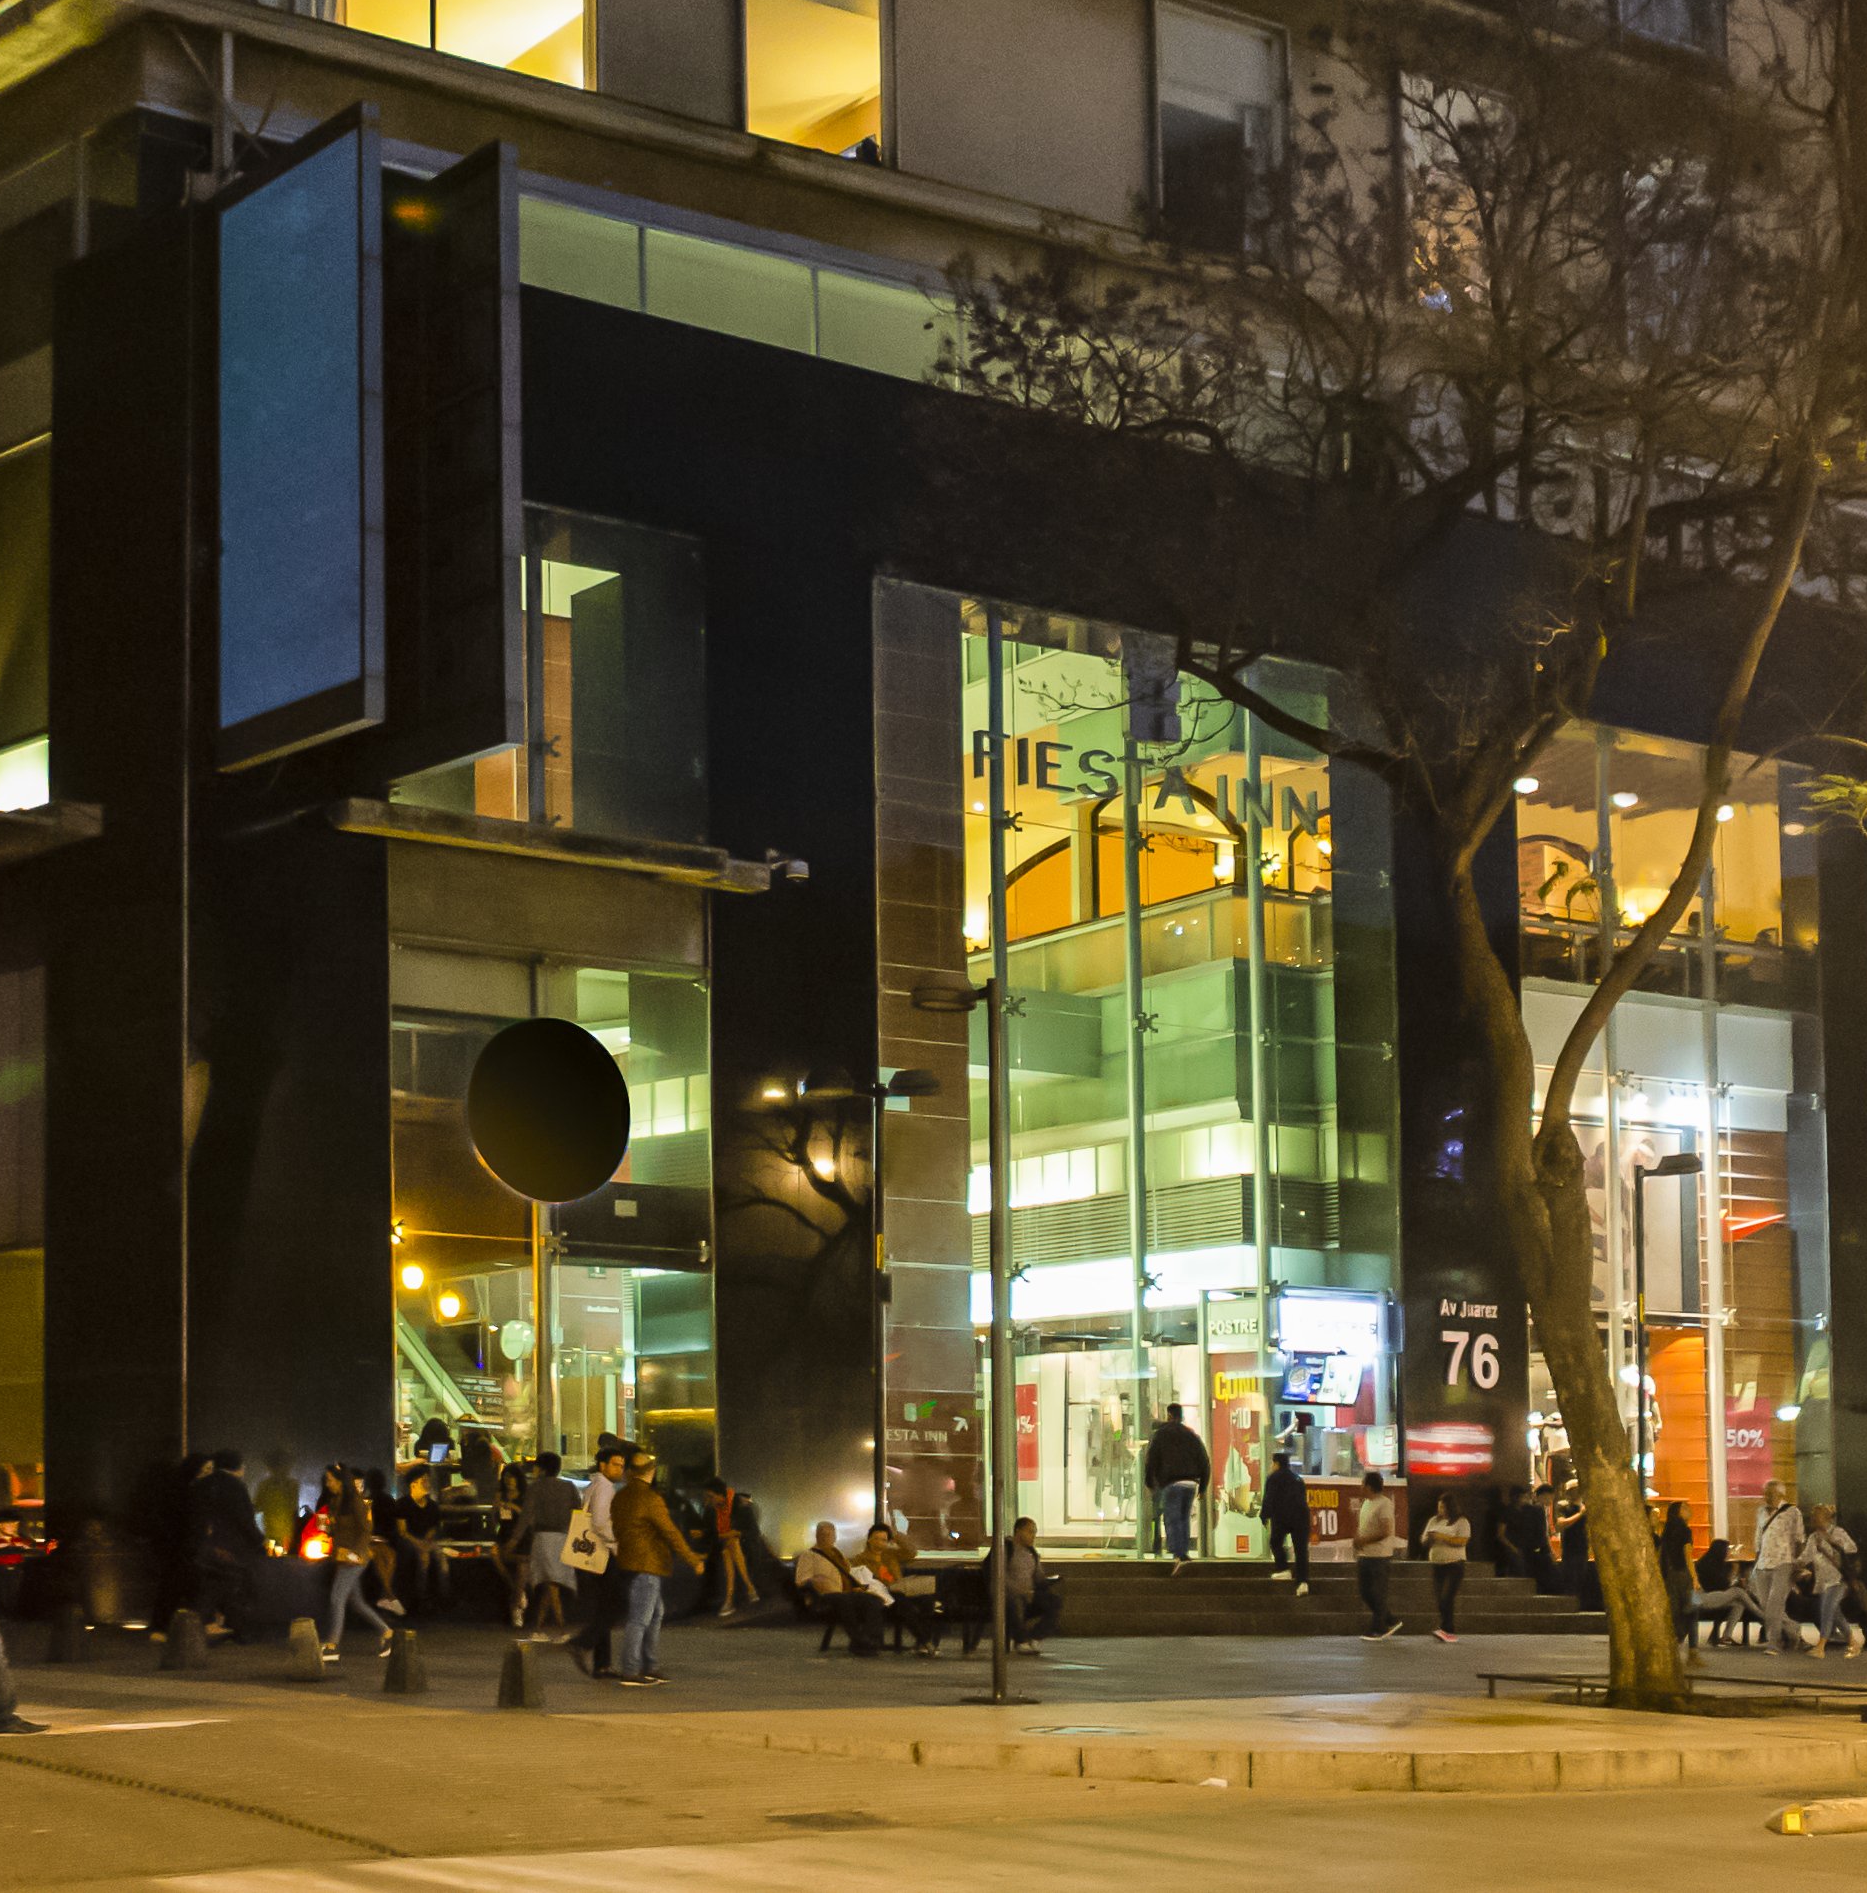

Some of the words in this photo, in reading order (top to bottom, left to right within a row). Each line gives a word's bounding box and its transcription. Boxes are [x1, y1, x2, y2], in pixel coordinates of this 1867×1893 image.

[973, 729, 1197, 816] FIESTA
[1216, 774, 1319, 835] INN
[1440, 1298, 1457, 1317] Av
[1459, 1300, 1498, 1319] Juarez
[1209, 1318, 1258, 1335] POSTRE
[1441, 1330, 1500, 1390] 76
[886, 1429, 919, 1442] ESTA
[1726, 1428, 1765, 1448] 50%
